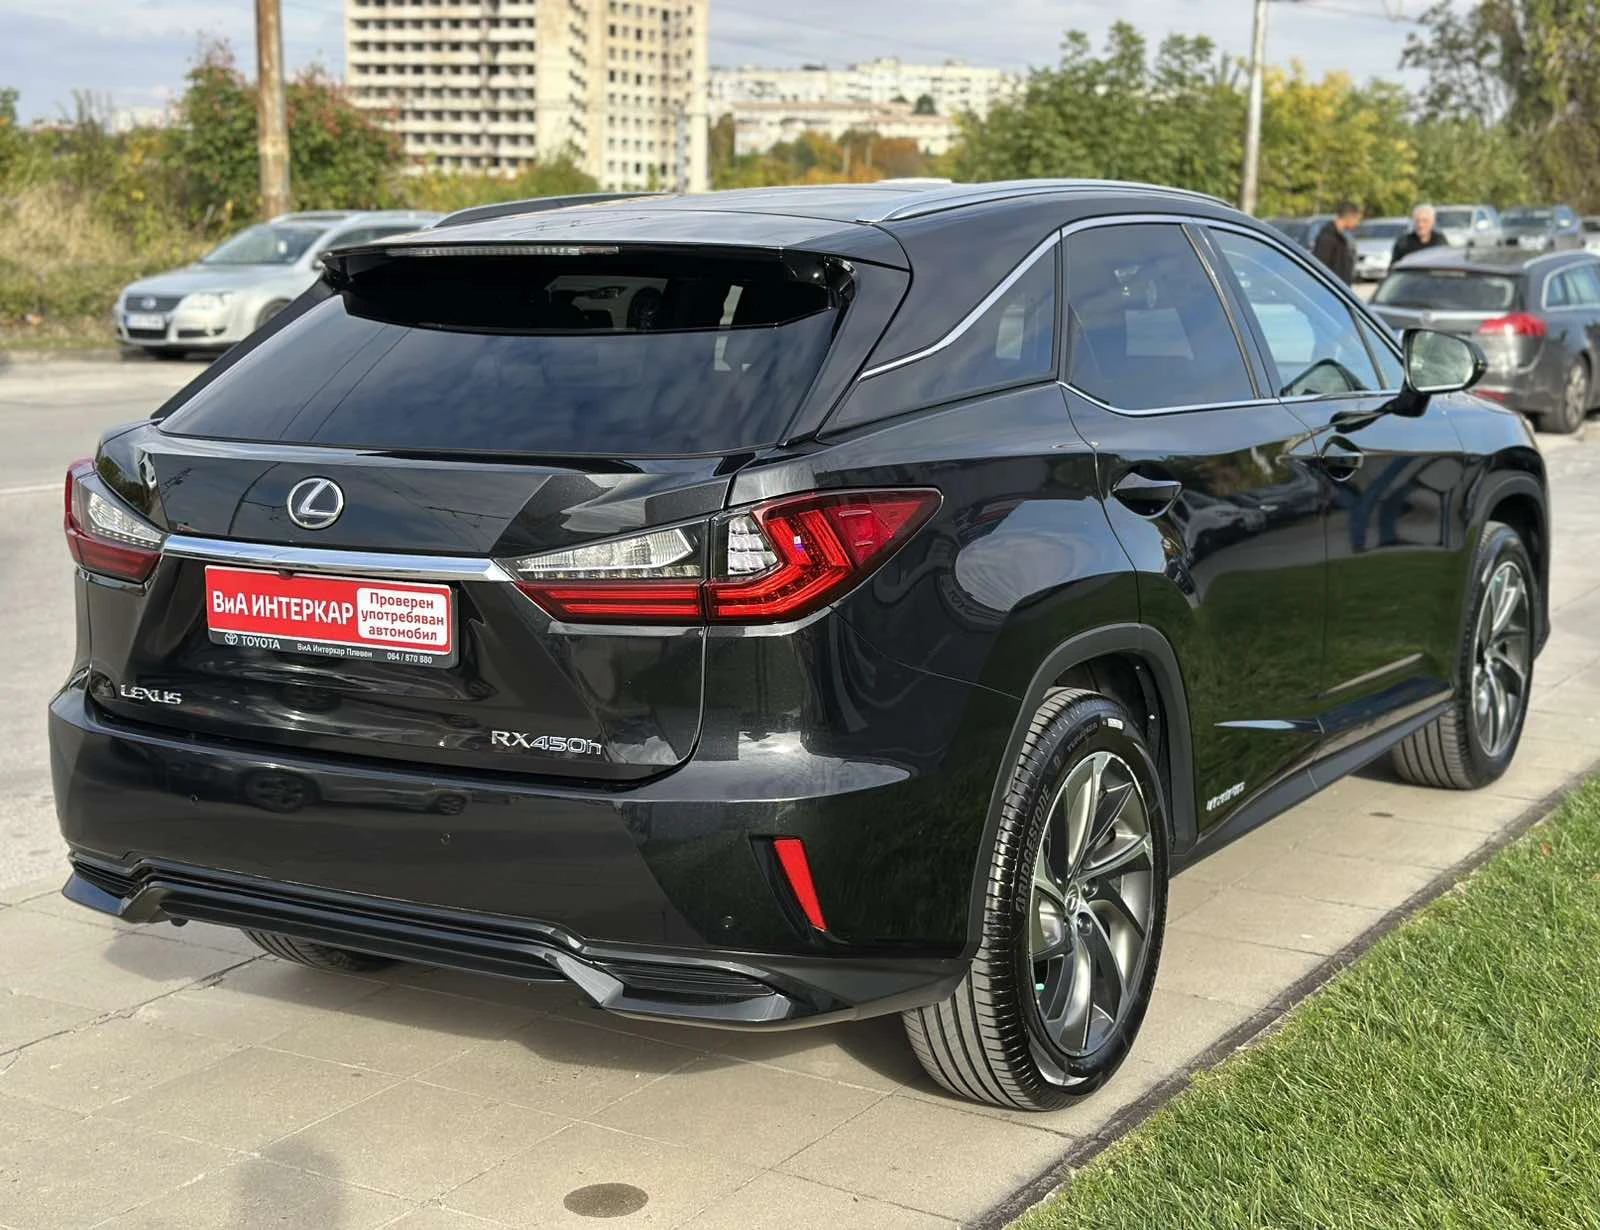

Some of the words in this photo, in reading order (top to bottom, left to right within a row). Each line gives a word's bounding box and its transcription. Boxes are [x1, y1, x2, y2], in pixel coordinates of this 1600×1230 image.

[212, 590, 249, 616] ВиА
[251, 593, 354, 625] ИНТЕРКАР
[370, 591, 434, 611] Проверен
[361, 609, 444, 626] употребяван
[240, 635, 281, 650] TOYOTA
[368, 625, 438, 641] автомобил
[312, 644, 345, 656] Интеркар
[346, 647, 373, 659] Плевен
[120, 684, 183, 705] LEXUS
[491, 730, 602, 755] RX450h
[1015, 783, 1051, 914] BRIDGESTONE
